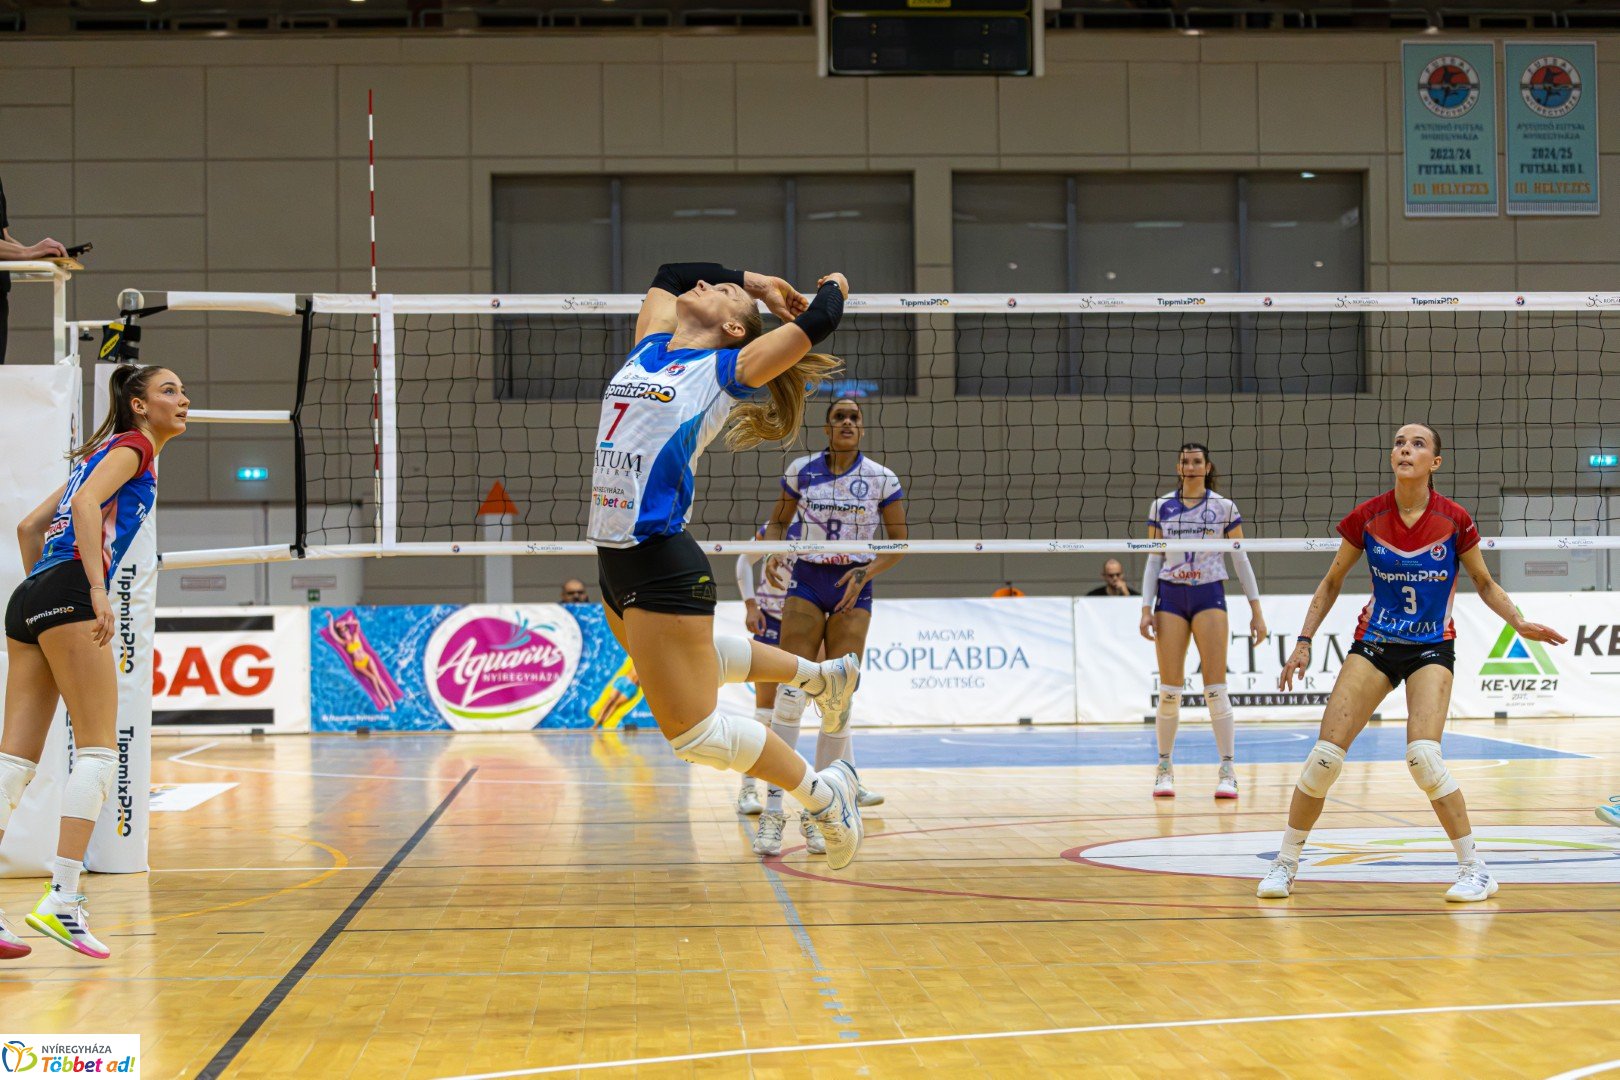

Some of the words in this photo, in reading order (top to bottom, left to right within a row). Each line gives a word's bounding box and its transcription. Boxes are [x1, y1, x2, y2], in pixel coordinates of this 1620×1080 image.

[1532, 147, 1573, 160] 2024/25
[1418, 164, 1458, 175] FUTSAL
[1520, 163, 1560, 174] FUTSAL
[900, 298, 949, 307] TippmixPRO
[1157, 298, 1206, 307] TippmixPRO
[1411, 297, 1459, 306] TippmixPRO
[604, 402, 630, 441] 7
[867, 543, 909, 551] TippmixPRO
[1126, 542, 1168, 550] TippmixPRO
[1370, 566, 1449, 583] TippmixPRO
[1401, 586, 1417, 615] 3
[25, 605, 75, 627] TippmixPRO
[117, 564, 137, 674] TippmixPRO
[1376, 607, 1438, 634] FATUM
[918, 629, 975, 642] MAGYAR
[867, 642, 1030, 672] RÖPLABDA
[436, 637, 563, 707] Aquarius
[911, 675, 986, 690] SZÖVETSÉG
[1481, 679, 1537, 691] KE-VIZ
[1540, 679, 1559, 691] 21
[117, 726, 135, 837] TippmixPRO
